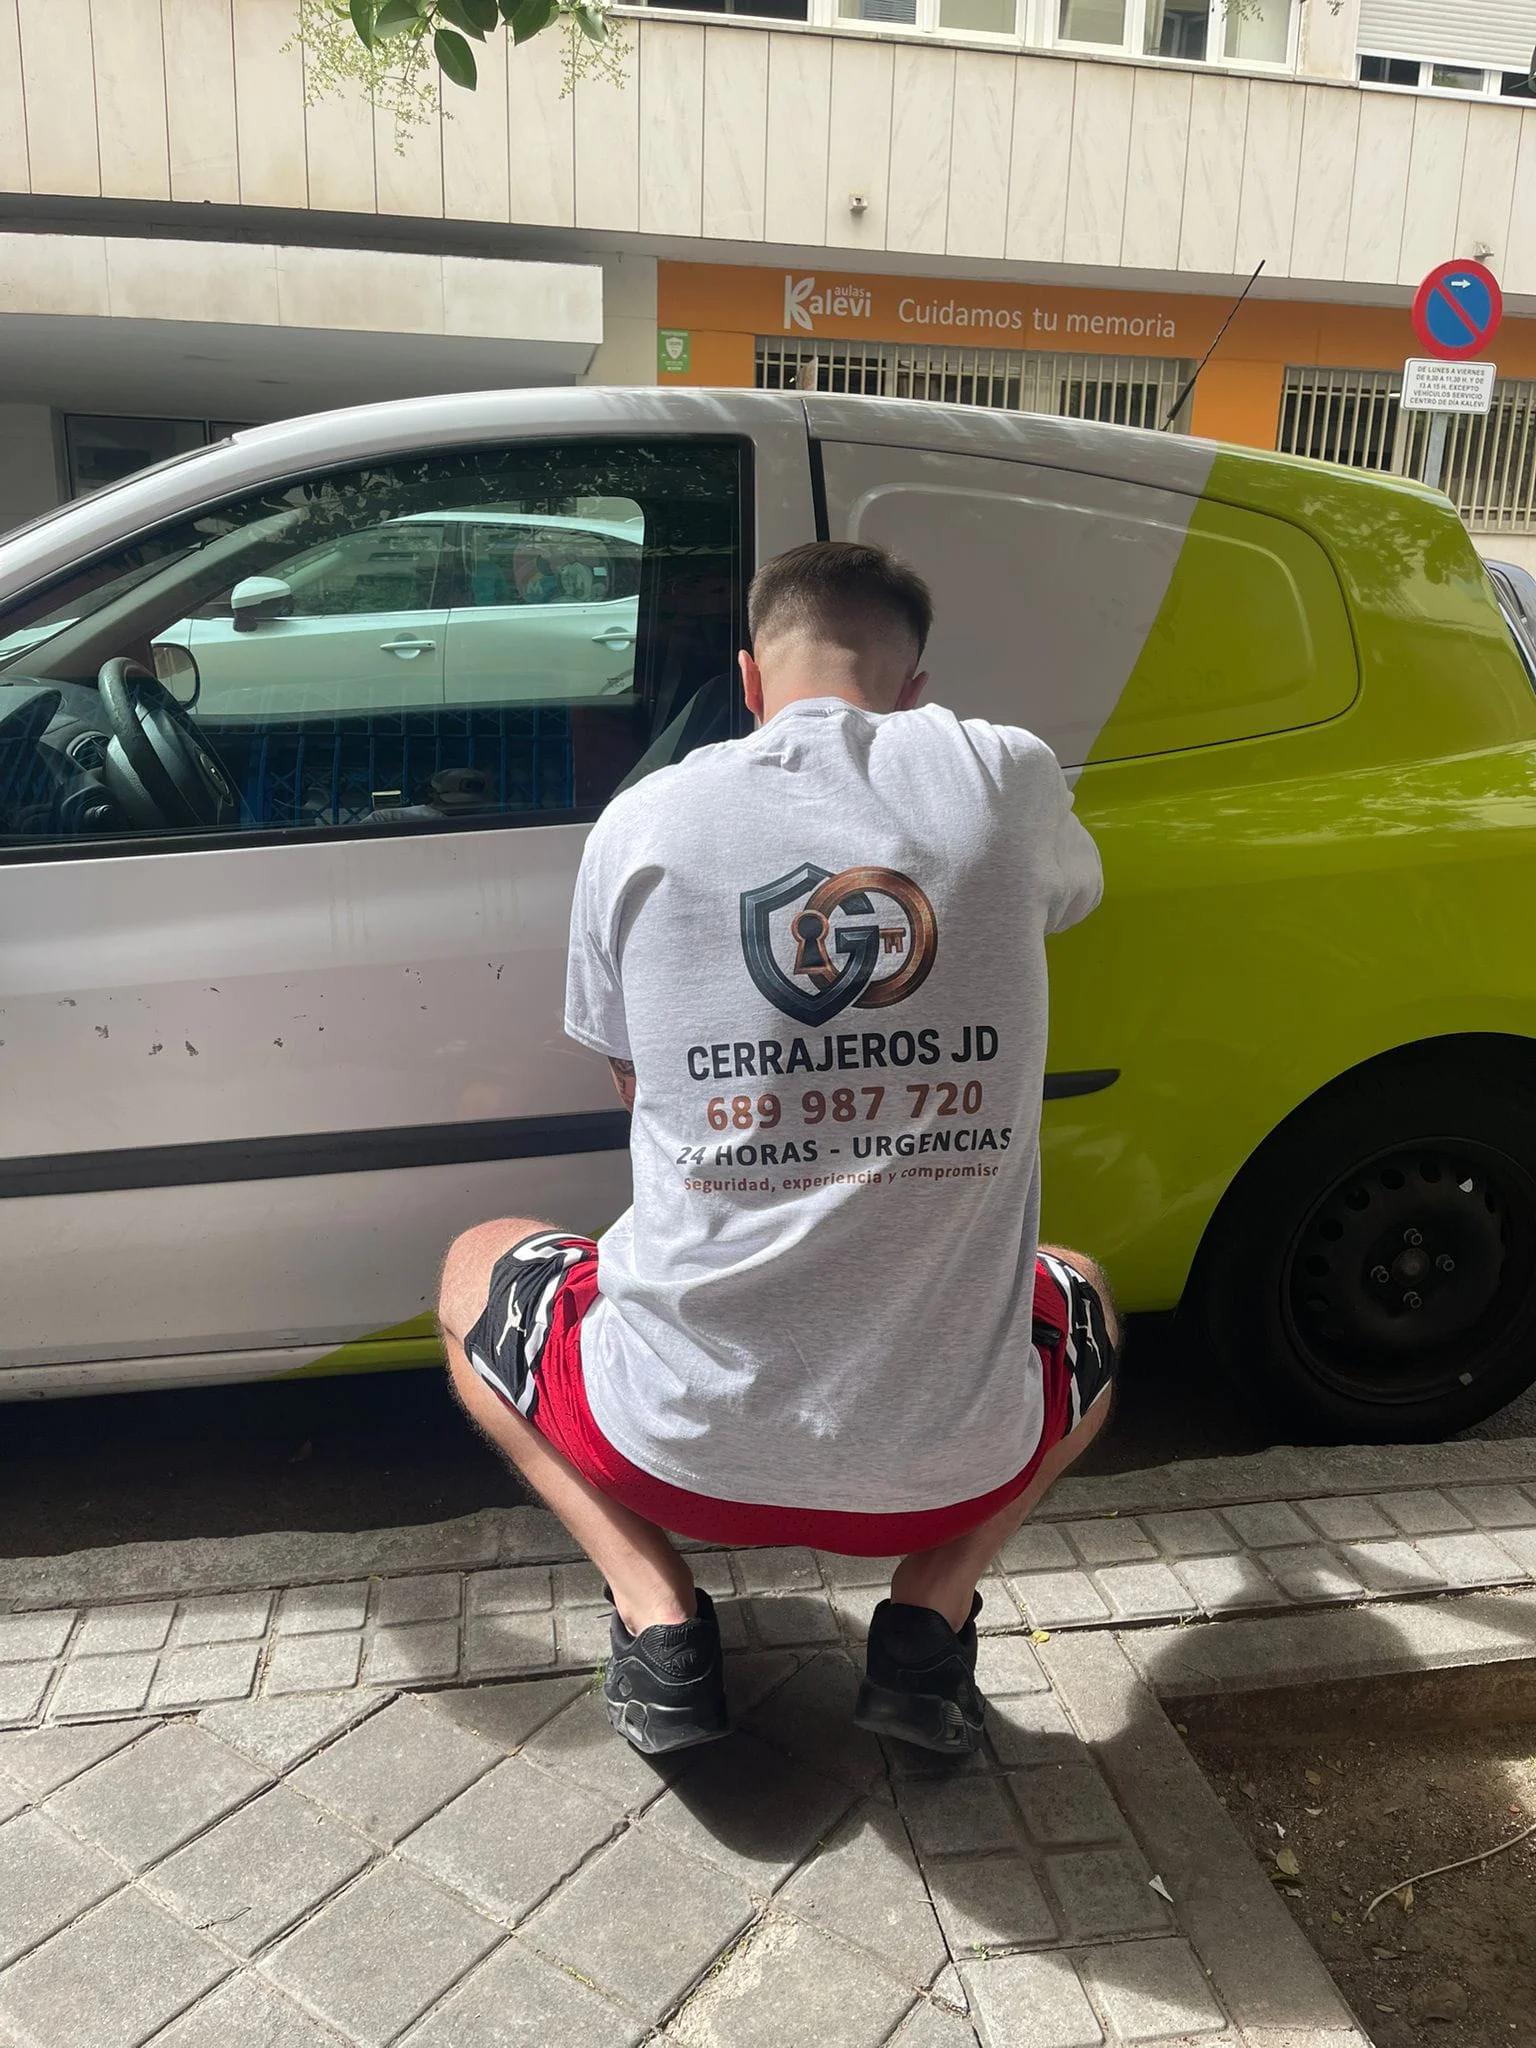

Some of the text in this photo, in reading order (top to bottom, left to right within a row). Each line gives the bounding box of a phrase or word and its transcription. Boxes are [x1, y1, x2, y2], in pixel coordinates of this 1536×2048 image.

[834, 285, 865, 297] aulas
[784, 275, 872, 331] Kalevi
[898, 298, 1176, 338] Cuidamos tu memoria
[1457, 368, 1485, 376] VIERNES
[1449, 384, 1480, 392] EXCEPTO
[1452, 392, 1483, 400] SERVICIO
[1410, 397, 1437, 405] CENTRO
[687, 1025, 999, 1081] CERRAJEROS JD
[707, 1080, 983, 1131] 689 987 720
[676, 1146, 707, 1165] 24
[715, 1139, 819, 1166] HORAS
[853, 1127, 1013, 1159] URGENCIAS
[684, 1178, 776, 1193] Seguridad,
[783, 1170, 882, 1191] experiencia
[888, 1172, 897, 1184] y
